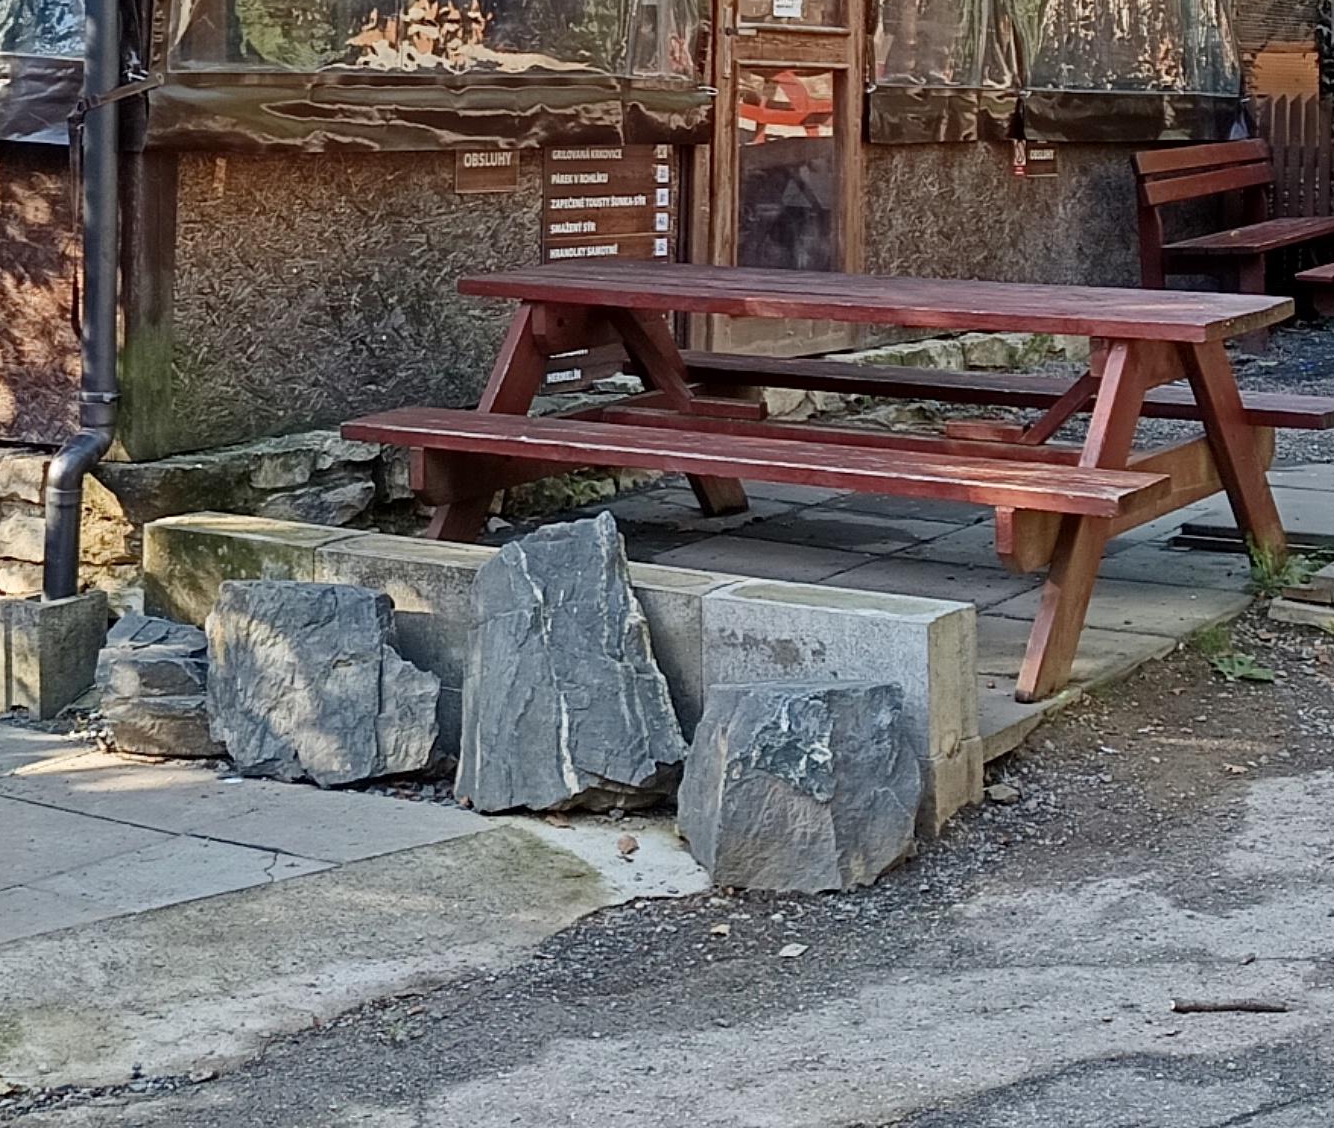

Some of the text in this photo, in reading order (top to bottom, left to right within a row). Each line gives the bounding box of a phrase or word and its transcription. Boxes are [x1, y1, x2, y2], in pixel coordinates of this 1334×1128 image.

[464, 151, 512, 168] OBSLUHY
[550, 220, 597, 234] SMAŽENÝ SÝR
